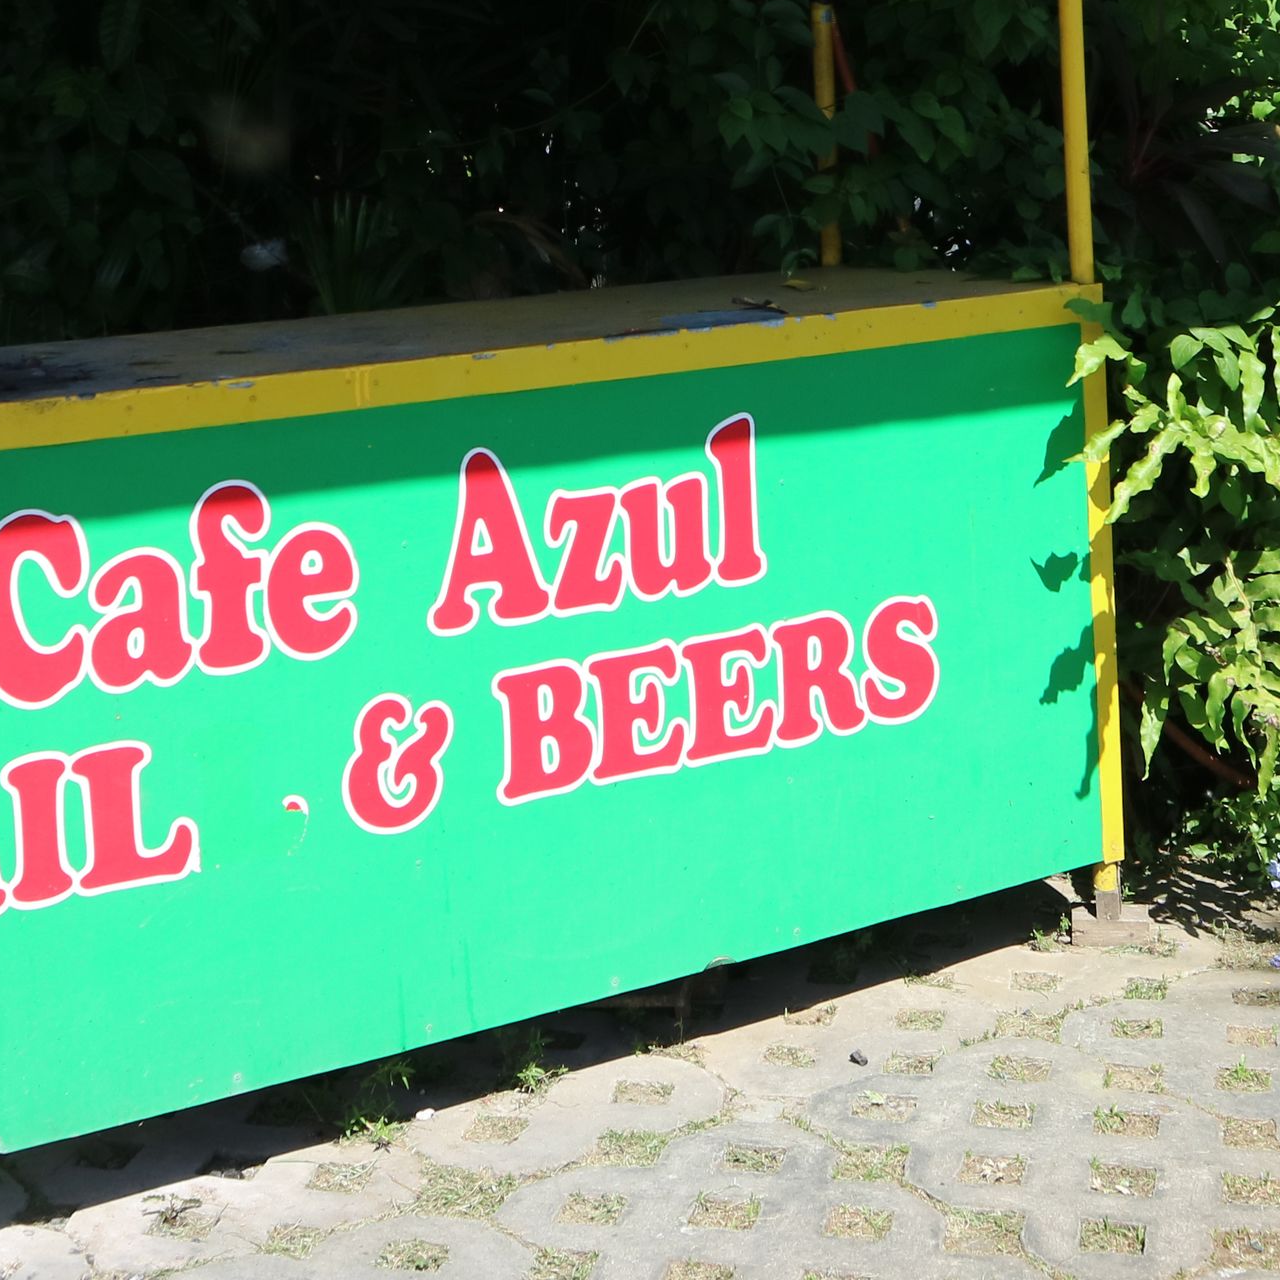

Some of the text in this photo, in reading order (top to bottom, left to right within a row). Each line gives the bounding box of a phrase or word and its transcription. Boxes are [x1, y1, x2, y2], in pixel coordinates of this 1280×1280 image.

[429, 415, 766, 634] Azul
[345, 695, 452, 832] &
[493, 598, 939, 804] BEERS
